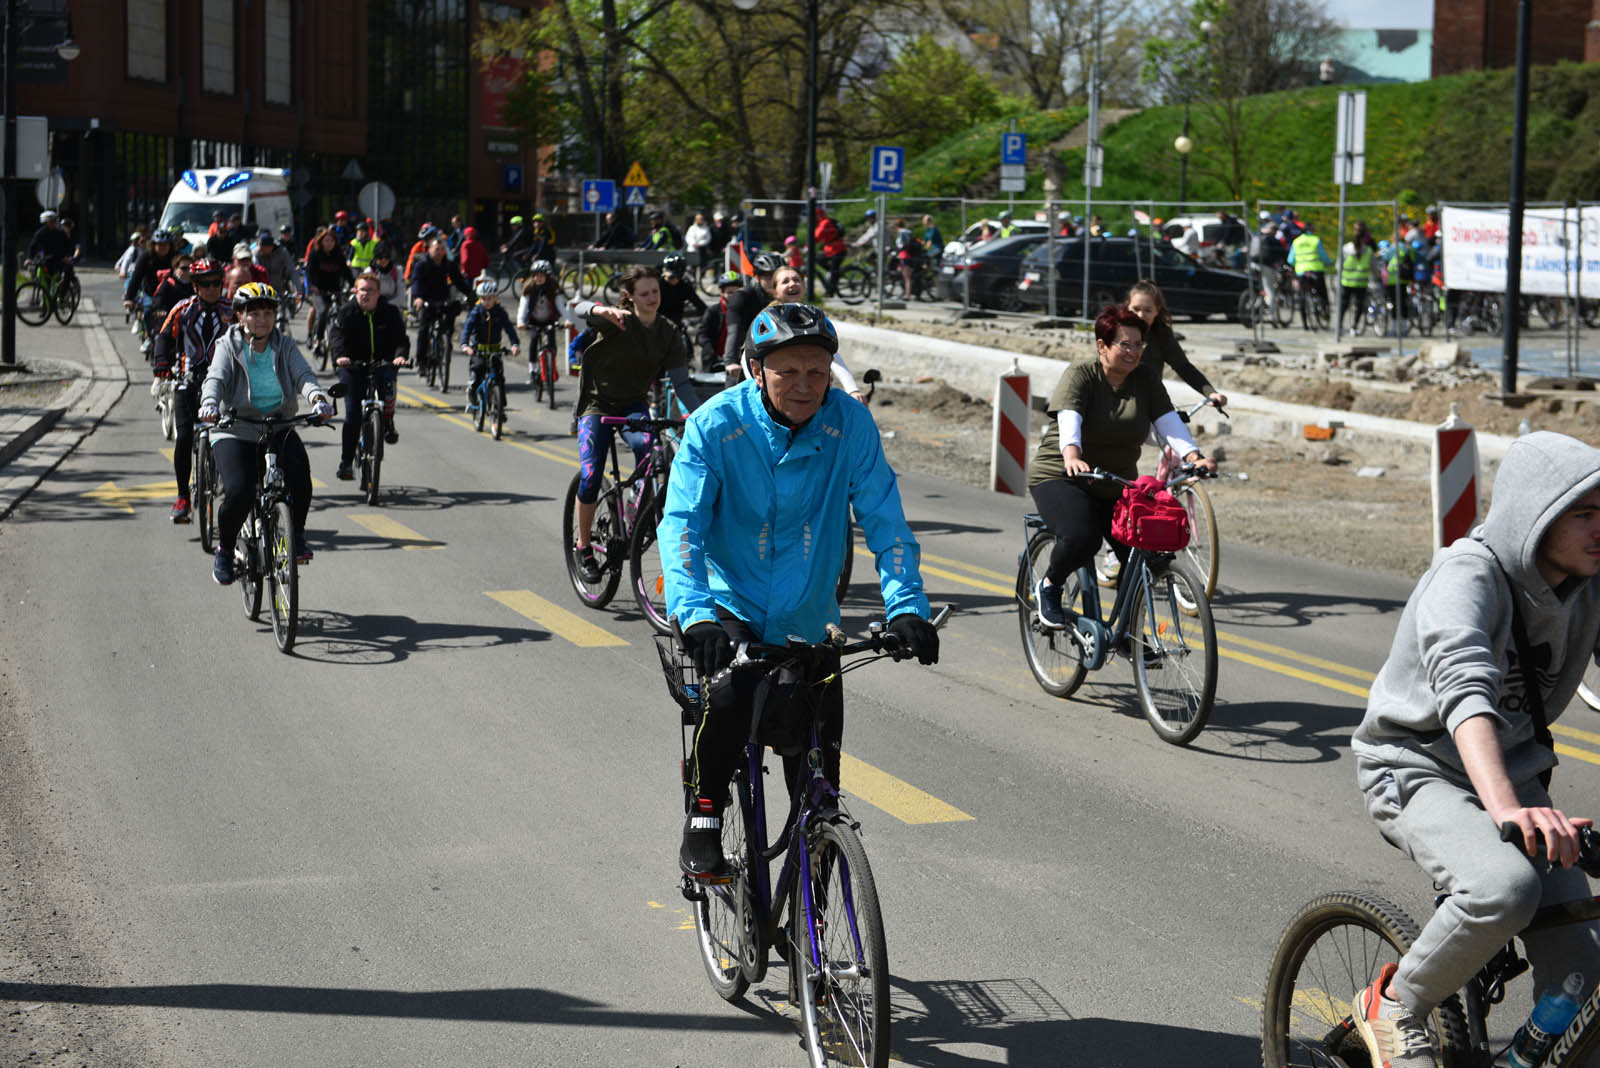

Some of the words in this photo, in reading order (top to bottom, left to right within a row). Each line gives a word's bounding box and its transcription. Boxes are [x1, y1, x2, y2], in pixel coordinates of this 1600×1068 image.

[1007, 135, 1021, 155] P
[879, 150, 898, 179] P
[690, 816, 721, 829] PUMA
